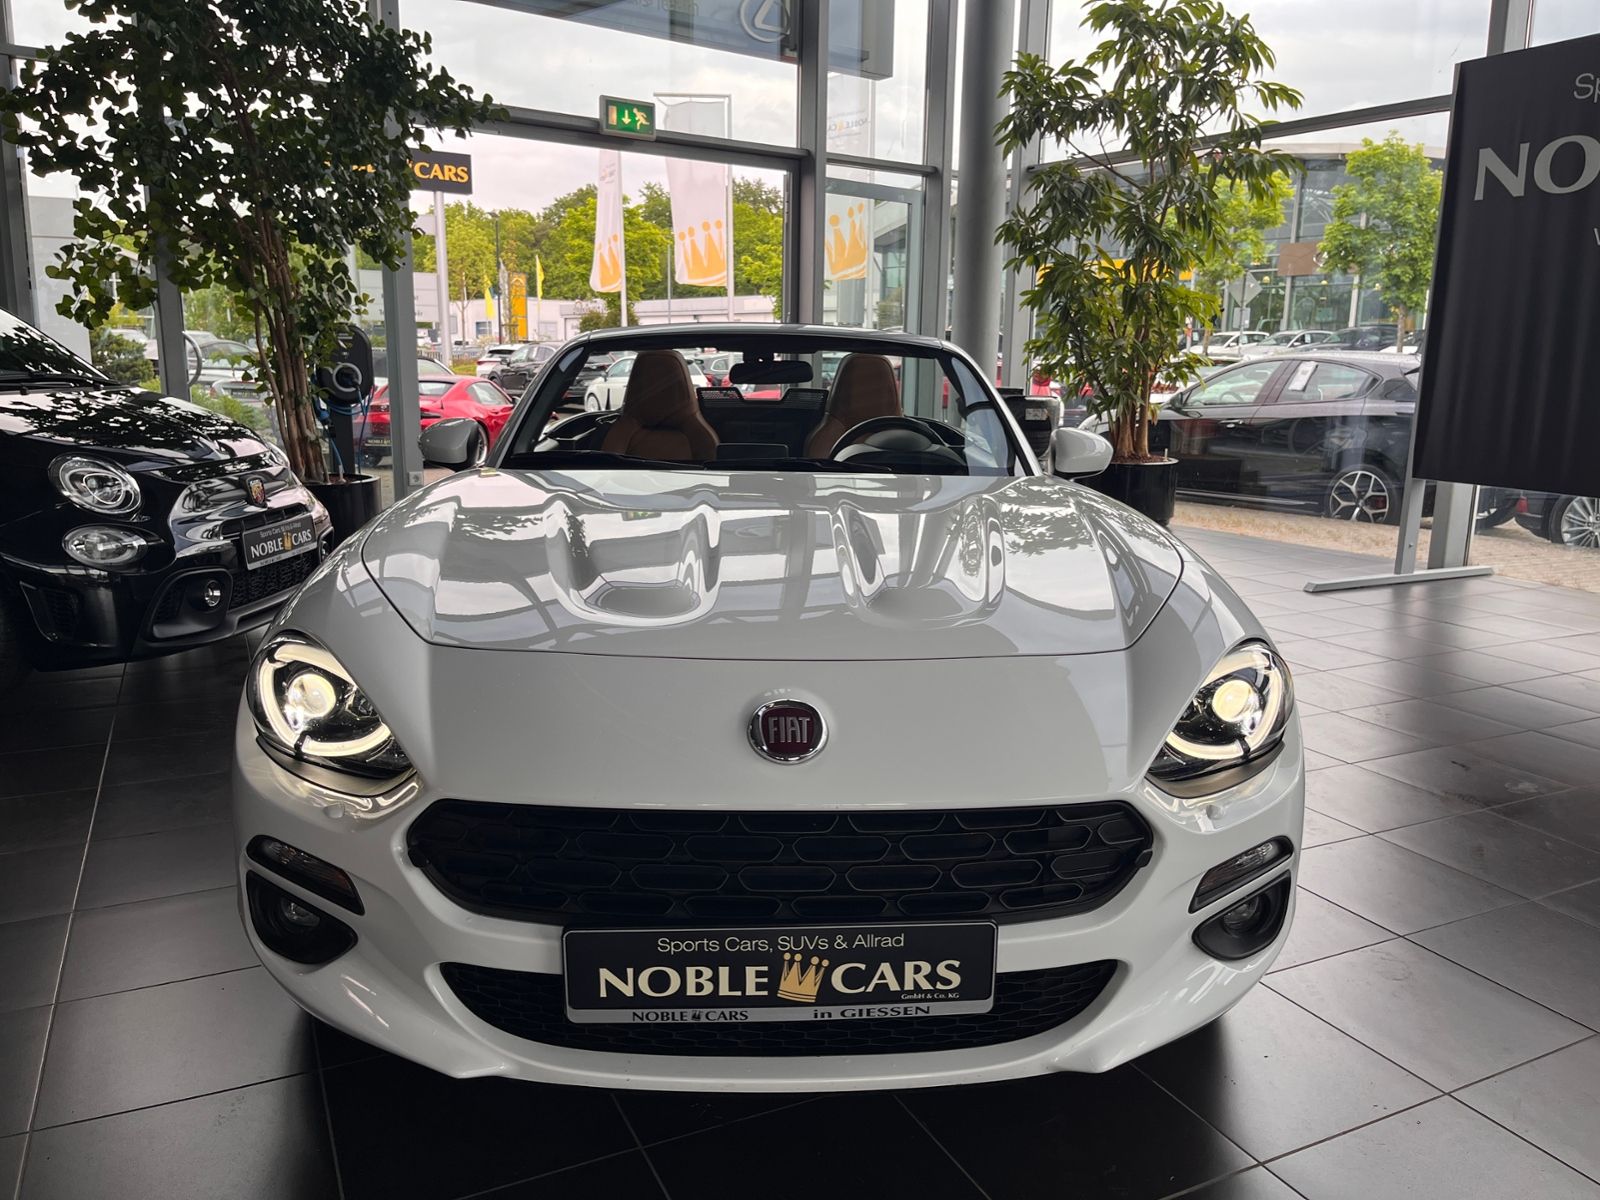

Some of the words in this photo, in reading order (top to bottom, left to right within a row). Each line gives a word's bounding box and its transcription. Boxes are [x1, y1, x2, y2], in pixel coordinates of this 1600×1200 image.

[414, 161, 469, 183] CARS
[250, 537, 284, 559] NOBLE
[292, 529, 312, 546] CARS
[768, 716, 810, 743] FIAT
[657, 937, 720, 955] Sports
[725, 936, 774, 953] Cars,
[777, 935, 829, 951] SUVs
[833, 934, 848, 949] &
[852, 933, 905, 948] Allrad
[599, 966, 769, 998] NOBLE
[831, 959, 961, 994] CARS
[632, 1010, 688, 1022] NOBLE
[705, 1010, 749, 1021] CARS
[813, 1009, 832, 1019] in
[839, 1005, 931, 1019] GIESSEN
